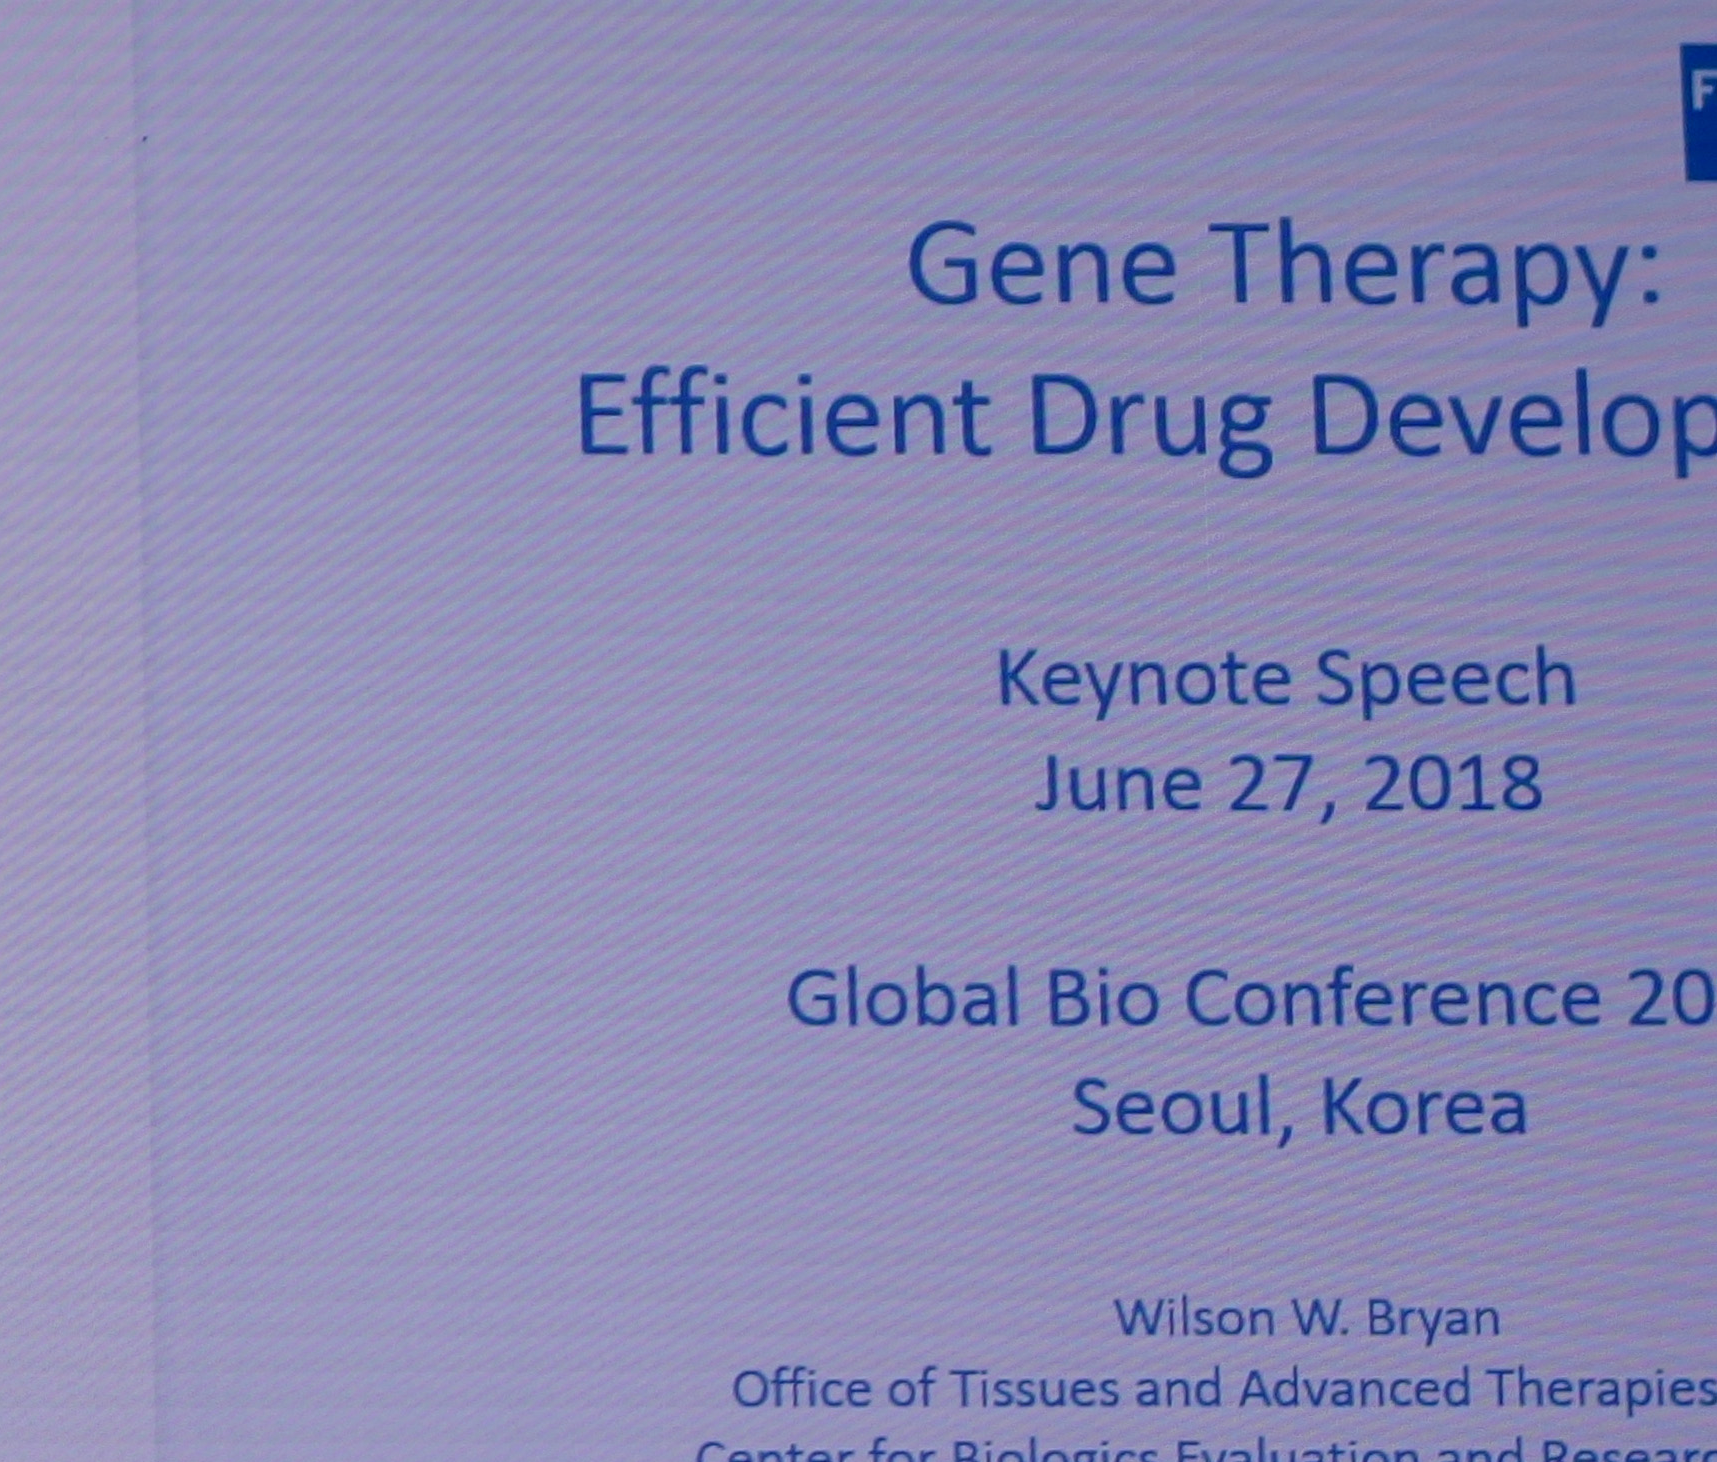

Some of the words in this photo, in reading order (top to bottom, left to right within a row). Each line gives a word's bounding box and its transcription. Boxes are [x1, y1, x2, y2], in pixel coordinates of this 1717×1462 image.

[909, 220, 1177, 306] Gene
[1208, 216, 1660, 329] Therapy:
[580, 364, 993, 458] Efficient
[1031, 373, 1274, 480] Drug
[1312, 367, 1717, 480] Develop
[999, 648, 1292, 721] Keynote
[1317, 644, 1577, 721] Speech
[1035, 754, 1202, 812] June
[1230, 753, 1335, 825] 27,
[1365, 753, 1543, 812] 2018
[788, 964, 1019, 1027] Global
[1049, 967, 1160, 1027] Bio
[1186, 964, 1601, 1027] Conference
[1629, 967, 1717, 1027] 20
[1074, 1073, 1293, 1148] Seoul,
[1323, 1077, 1527, 1136] Korea
[1114, 1295, 1274, 1336] Wilson
[1292, 1298, 1348, 1336] W.
[1368, 1298, 1500, 1347] Bryan
[734, 1365, 872, 1408] Office
[889, 1365, 936, 1407] of
[951, 1369, 1120, 1408] Tissues
[1136, 1366, 1221, 1407] and
[1240, 1365, 1471, 1408] Advanced
[1485, 1365, 1717, 1418] Therapies
